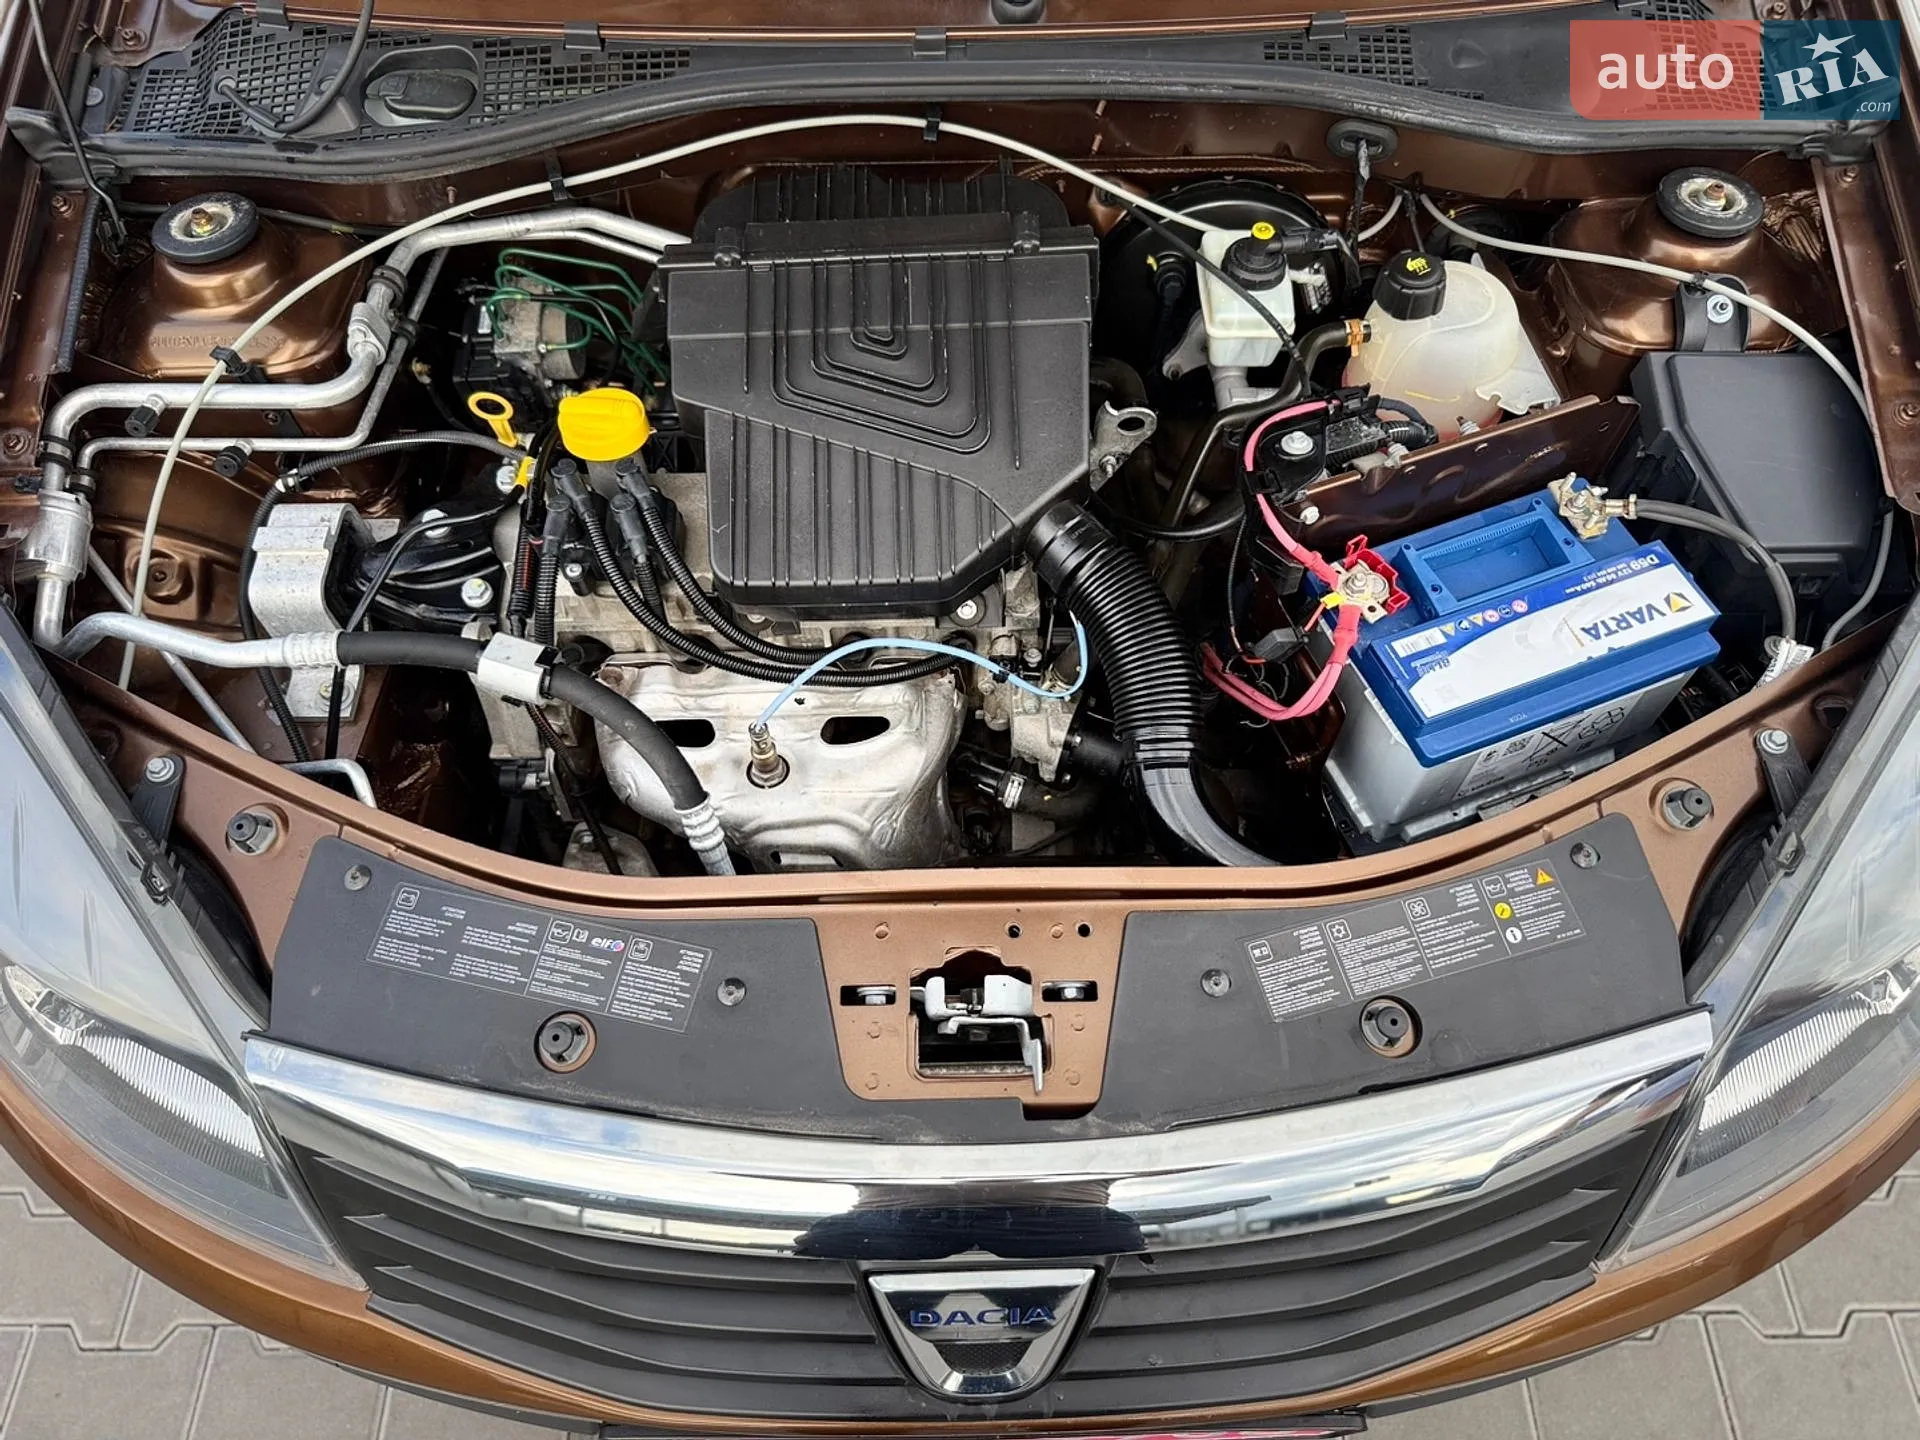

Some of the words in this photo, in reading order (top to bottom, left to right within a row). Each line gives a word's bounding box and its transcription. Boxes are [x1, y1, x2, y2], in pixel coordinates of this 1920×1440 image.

[1630, 554, 1659, 570] D59
[1580, 603, 1667, 641] VARTA
[591, 937, 614, 949] elf
[910, 1305, 1056, 1327] DACIA
